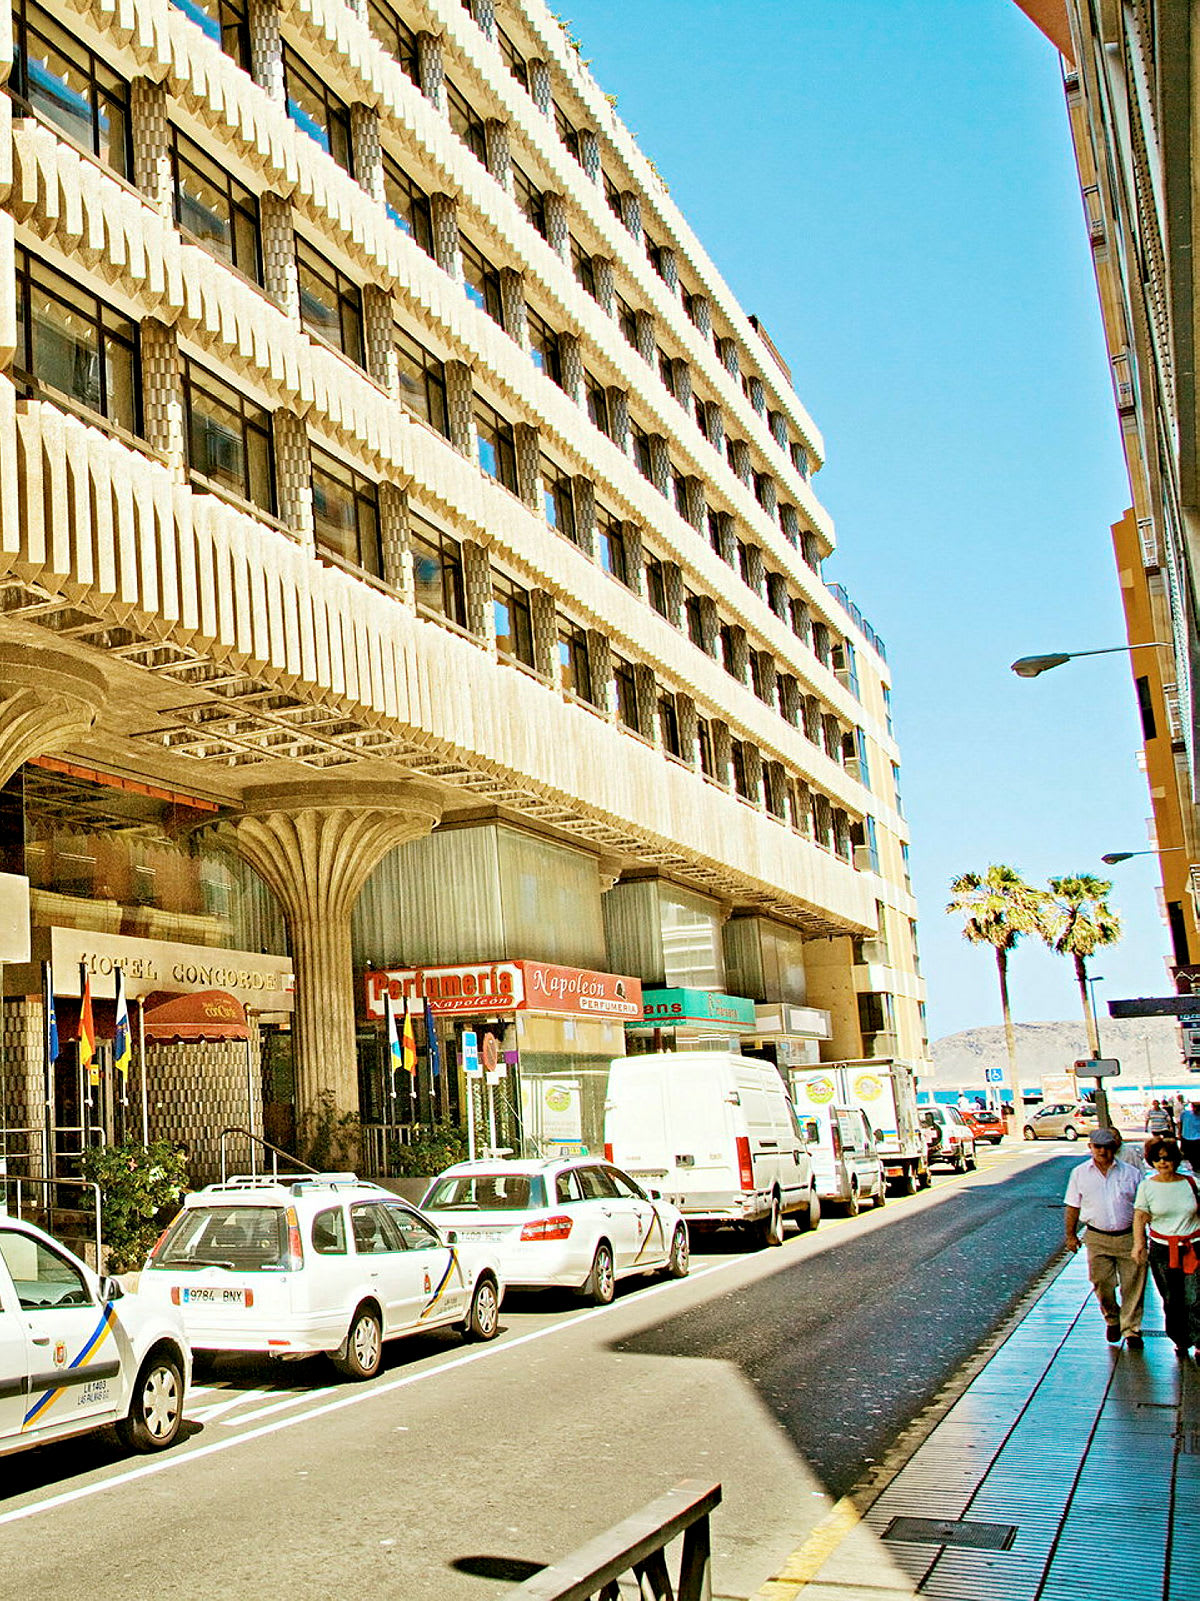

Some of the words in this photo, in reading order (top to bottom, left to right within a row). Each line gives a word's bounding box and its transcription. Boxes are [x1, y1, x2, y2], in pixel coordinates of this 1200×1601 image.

[172, 963, 277, 992] CONCORDE
[533, 969, 605, 998] Napoleón
[428, 996, 509, 1009] Napoleón
[190, 1290, 214, 1302] 9784
[223, 1291, 242, 1303] BNX
